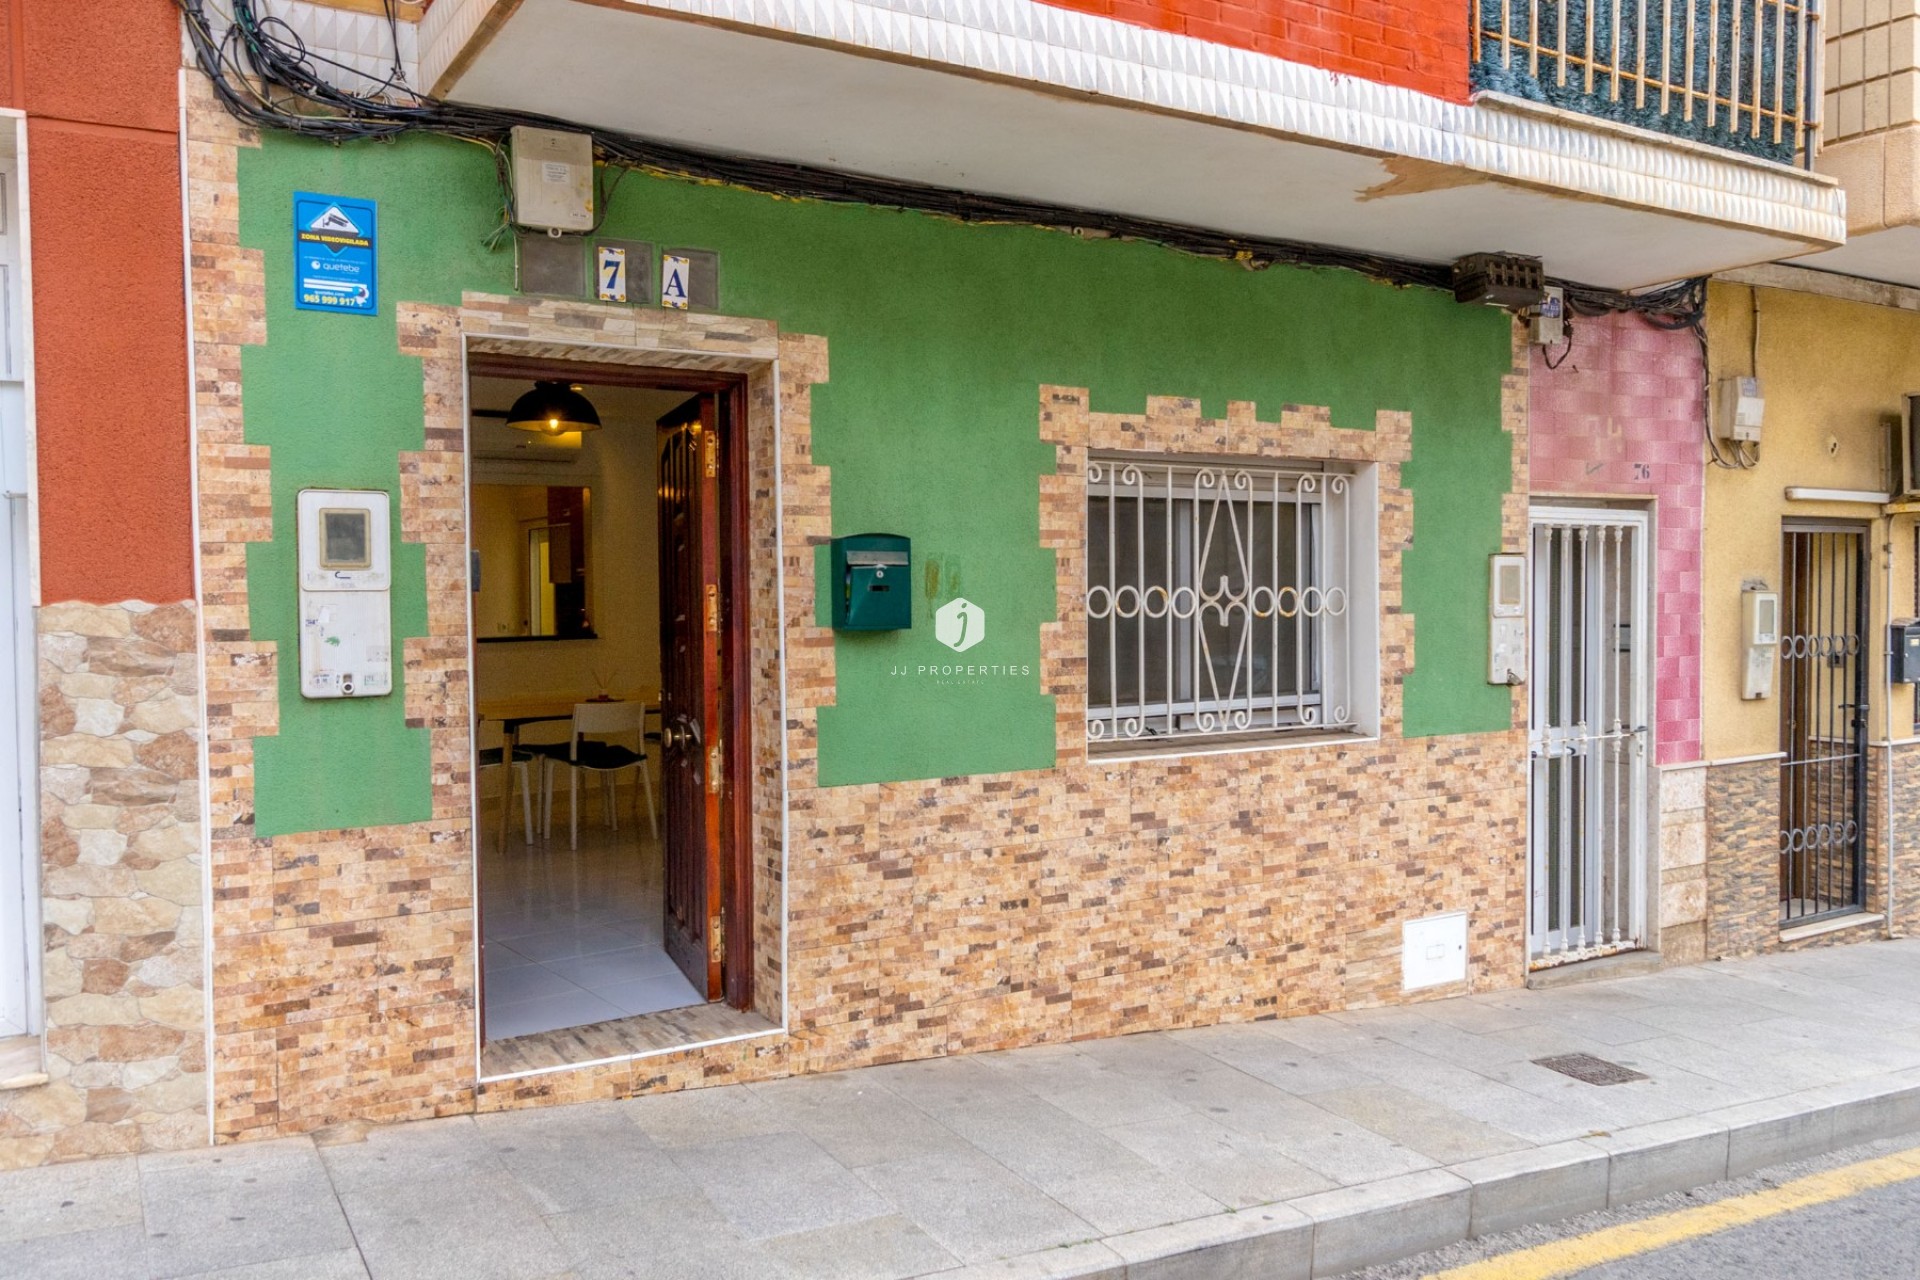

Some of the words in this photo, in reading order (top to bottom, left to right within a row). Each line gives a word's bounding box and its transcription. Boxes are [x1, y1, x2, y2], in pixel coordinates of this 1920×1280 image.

[301, 233, 319, 241] ZONA
[320, 235, 369, 247] VIDEOVIGILADA
[323, 263, 360, 272] quetebe
[603, 260, 620, 289] 7
[663, 269, 687, 298] A
[304, 294, 320, 303] 965
[322, 296, 338, 305] 999
[339, 297, 355, 306] 917
[1633, 463, 1650, 480] 76
